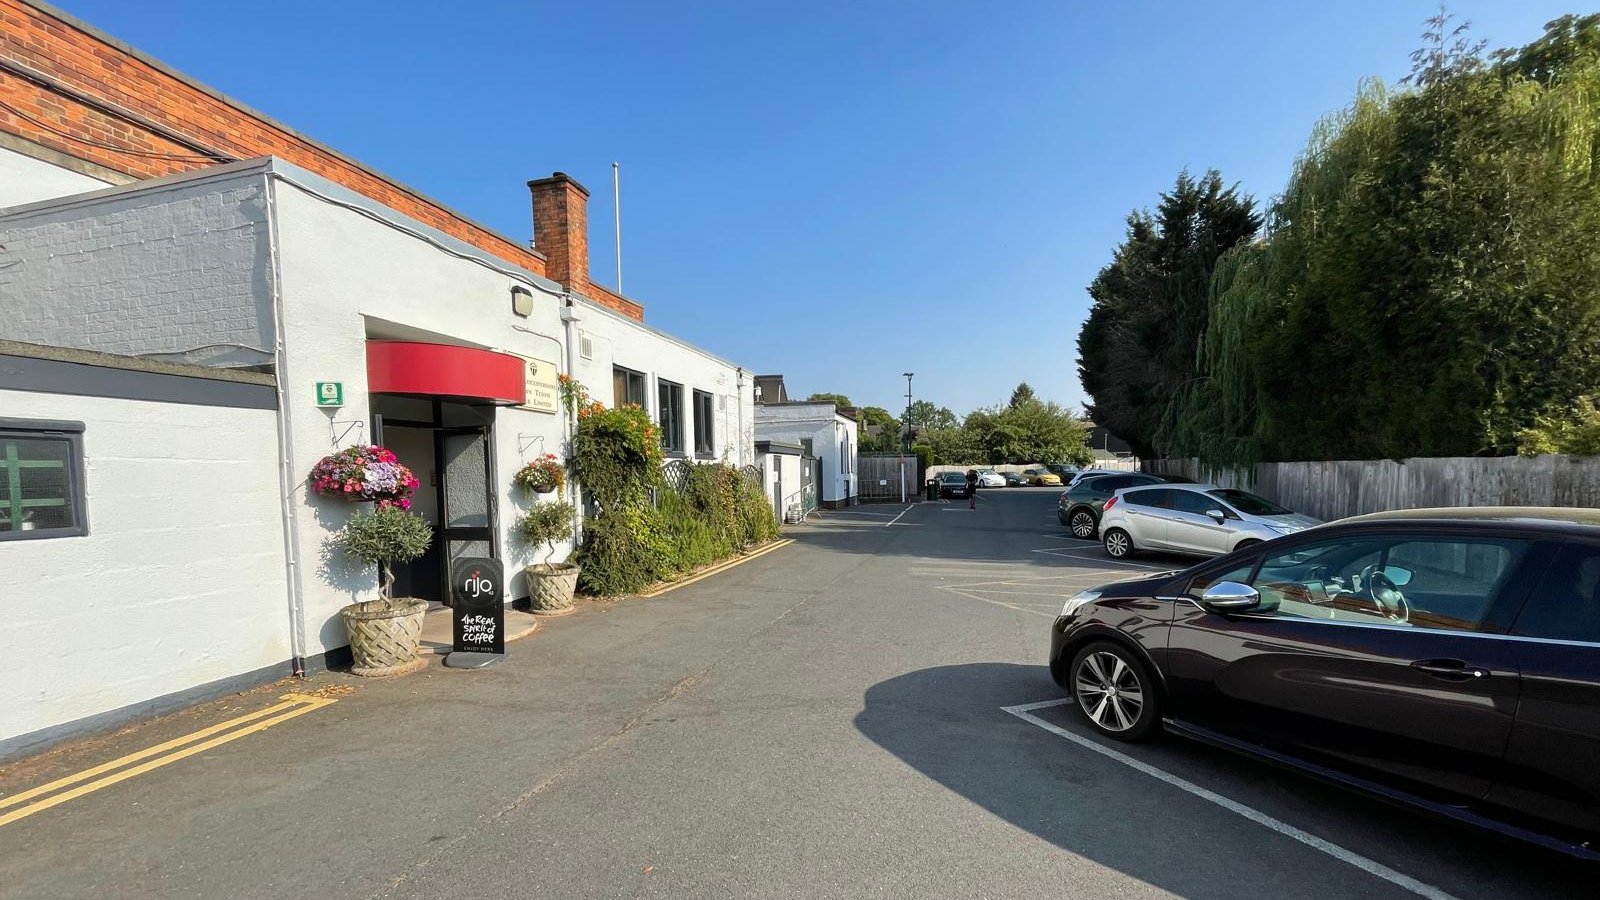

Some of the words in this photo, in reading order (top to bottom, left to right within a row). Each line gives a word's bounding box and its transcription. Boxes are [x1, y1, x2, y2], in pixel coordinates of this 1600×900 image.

[465, 570, 492, 597] rijo
[461, 613, 475, 625] The
[487, 625, 496, 634] of
